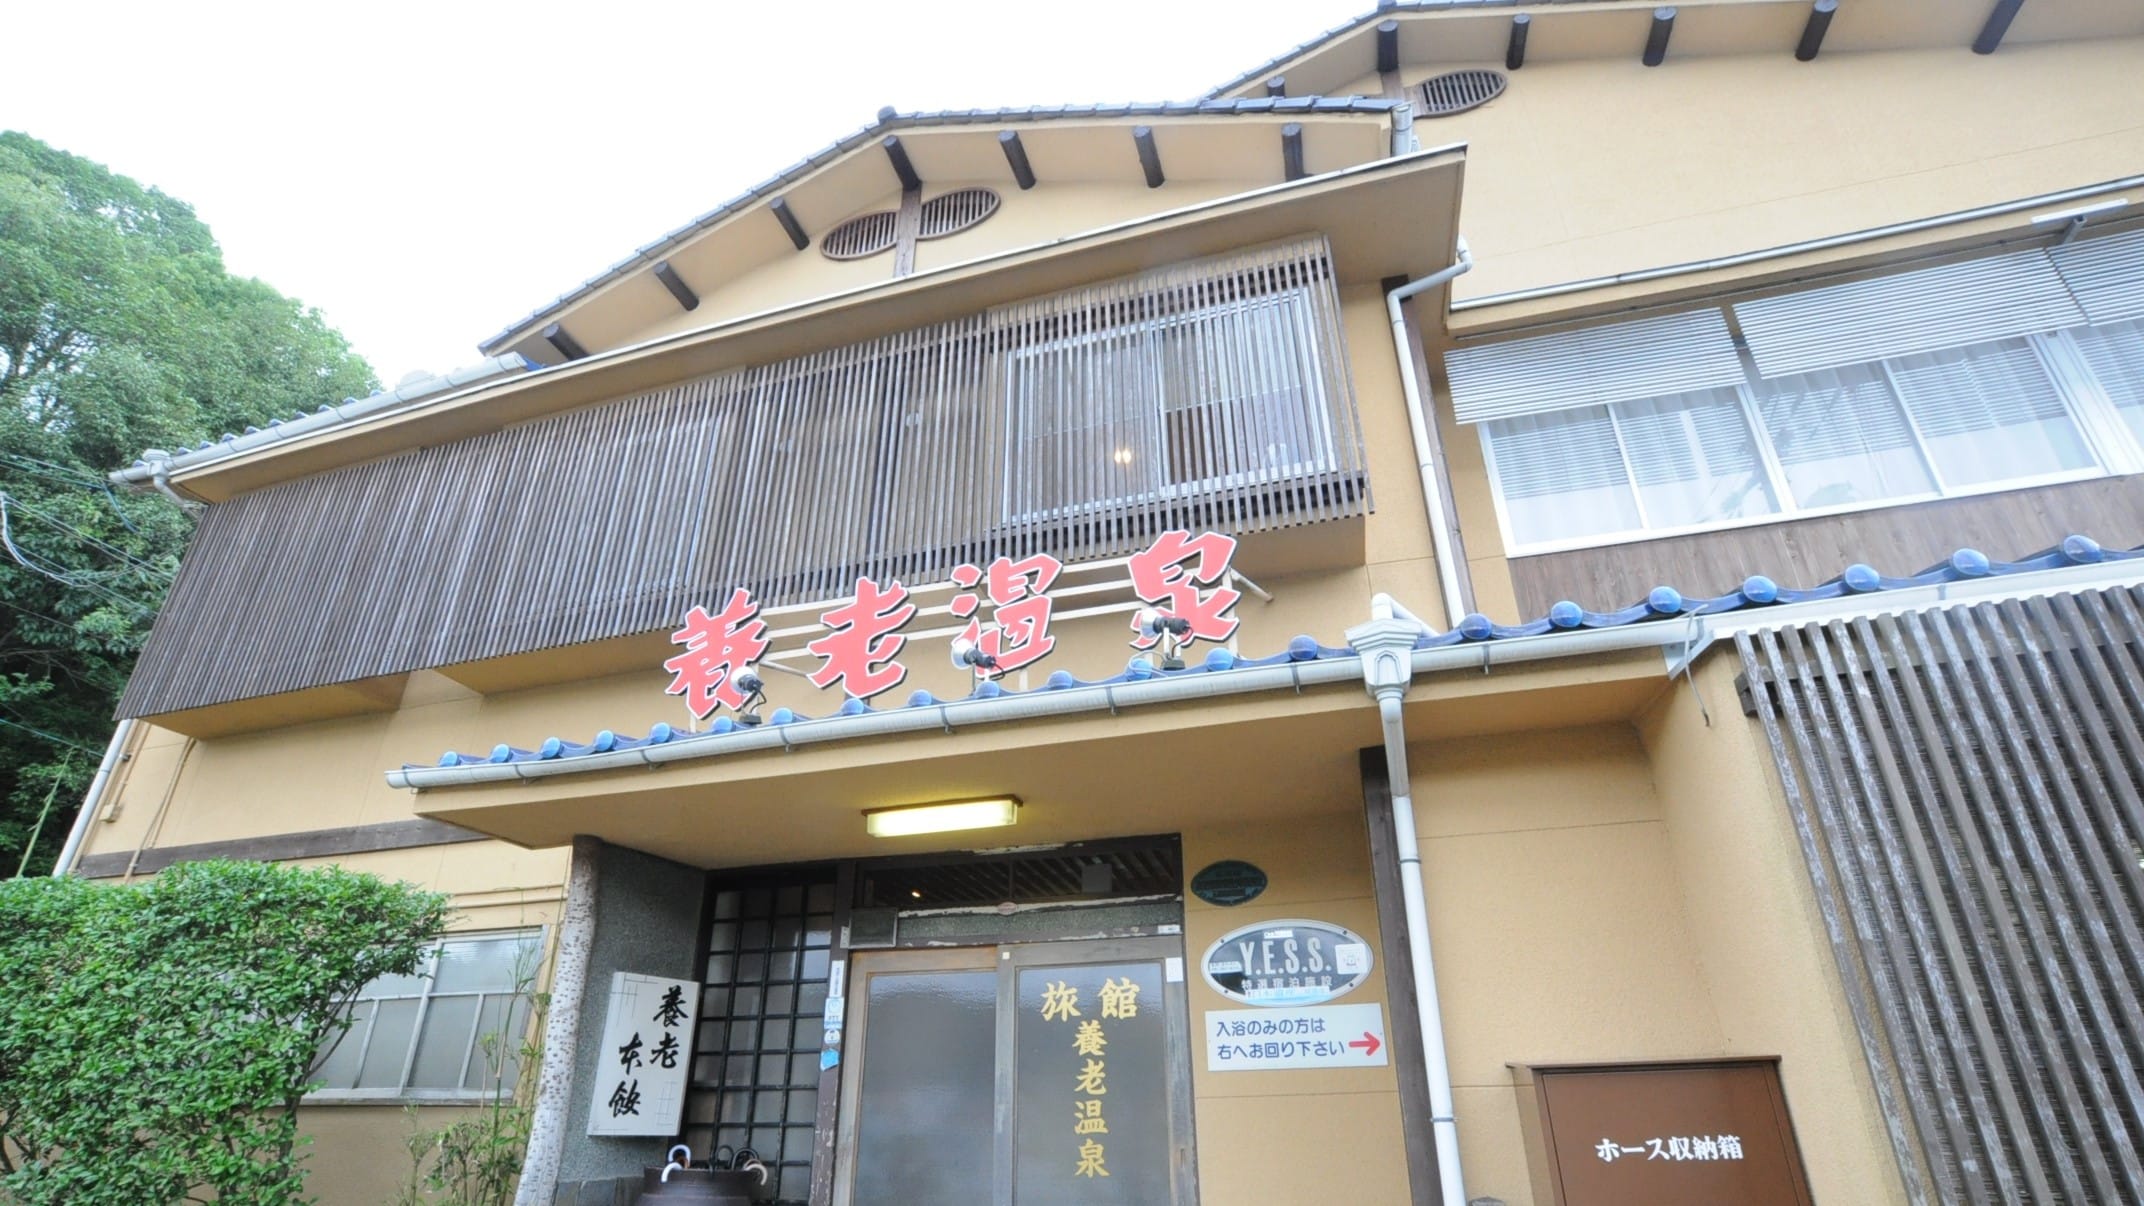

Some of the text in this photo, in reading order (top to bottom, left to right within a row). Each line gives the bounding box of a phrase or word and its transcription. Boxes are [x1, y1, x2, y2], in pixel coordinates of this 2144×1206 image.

[664, 529, 1240, 719] 養老温泉
[1239, 937, 1332, 975] Y.E.S.S.
[1040, 977, 1140, 1022] 旅館
[650, 985, 689, 1069] 養老
[1216, 1018, 1326, 1037] 入浴のみの方は
[1217, 1041, 1345, 1060] 右へお回り下さい
[1072, 1019, 1111, 1178] 養老温泉
[1595, 1135, 1744, 1162] ホース収納箱
